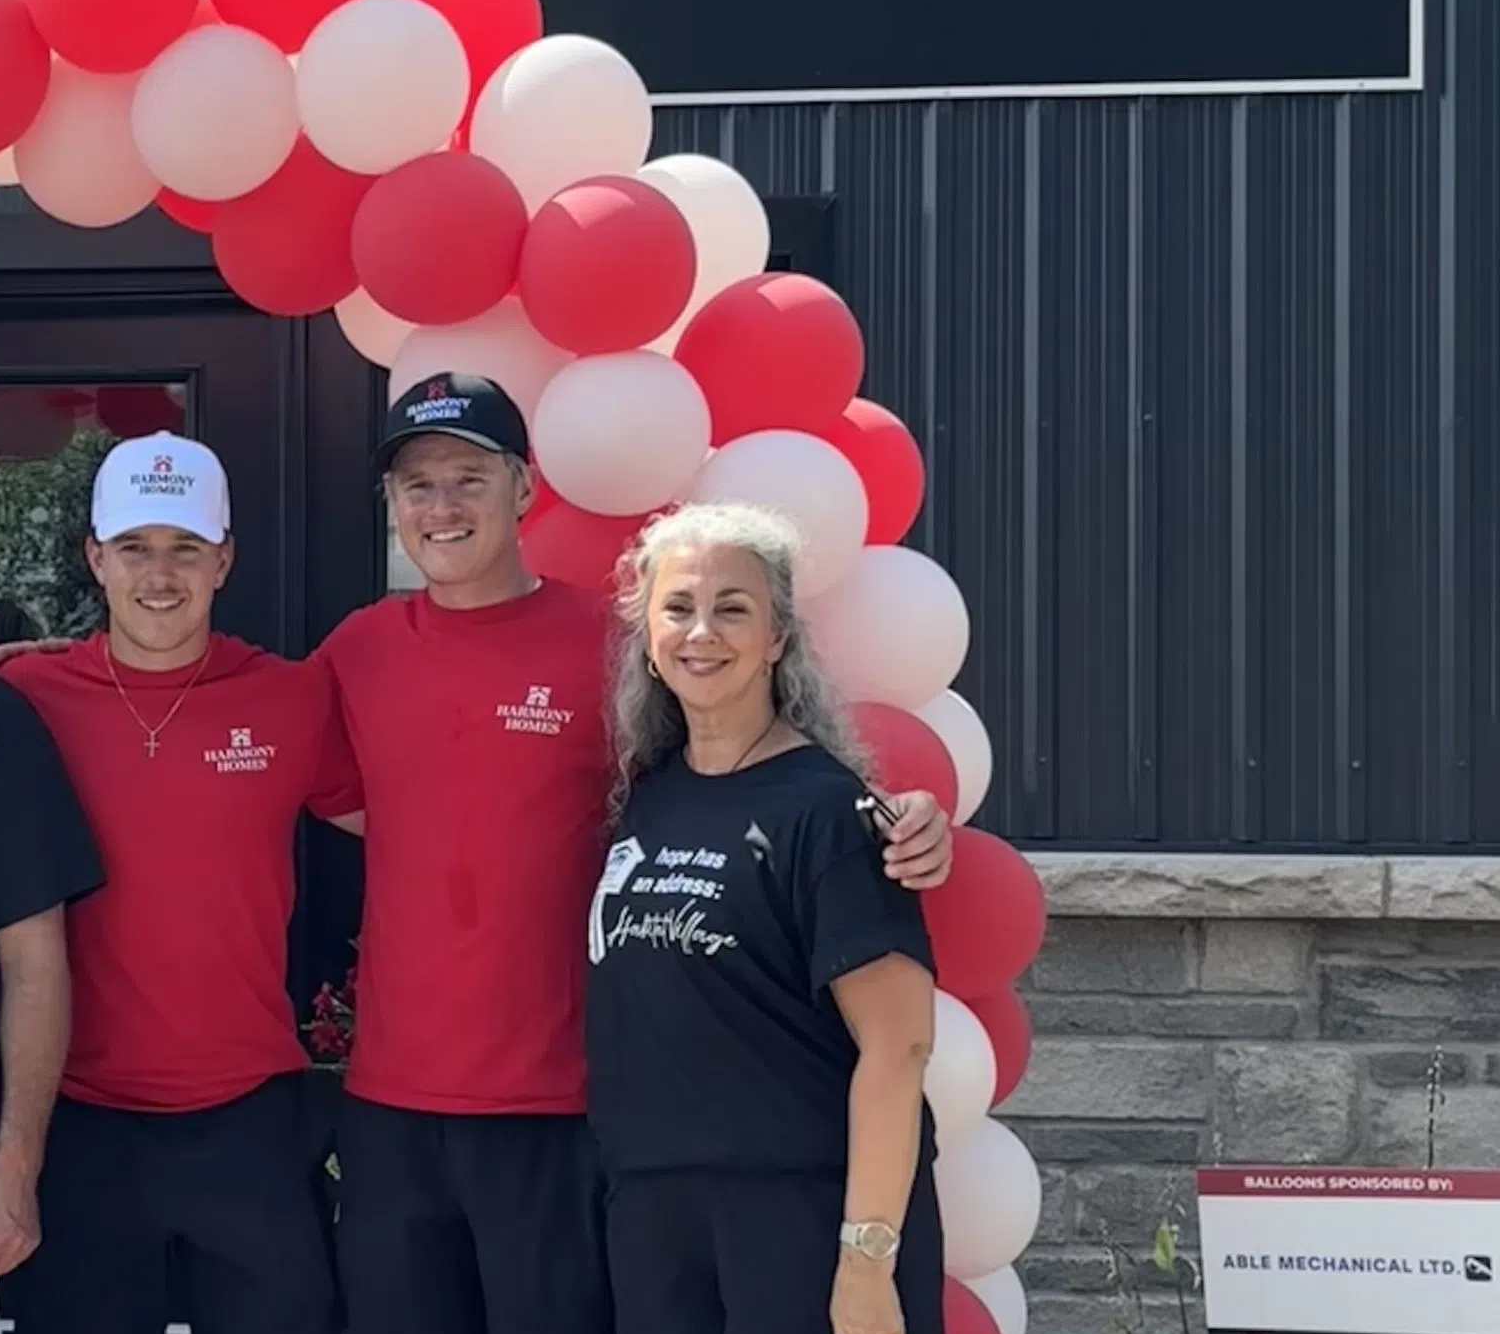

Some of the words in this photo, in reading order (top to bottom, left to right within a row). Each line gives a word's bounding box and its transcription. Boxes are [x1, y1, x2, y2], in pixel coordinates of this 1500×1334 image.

[130, 473, 196, 488] HARMONY
[139, 484, 186, 496] HOMES
[495, 704, 575, 724] HARMONY
[504, 717, 561, 735] HOMES
[203, 745, 278, 763] HARMONY
[216, 758, 268, 773] HOMES
[655, 845, 693, 869] hope
[692, 847, 728, 869] has
[632, 877, 653, 893] an
[654, 872, 725, 900] address:
[1244, 1175, 1326, 1190] BALLOONS
[1328, 1176, 1425, 1191] SPONSORED
[1427, 1177, 1454, 1191] BY:
[1223, 1254, 1271, 1270] ABLE
[1278, 1255, 1413, 1274] MECHANICAL
[1419, 1258, 1462, 1276] LTD.
